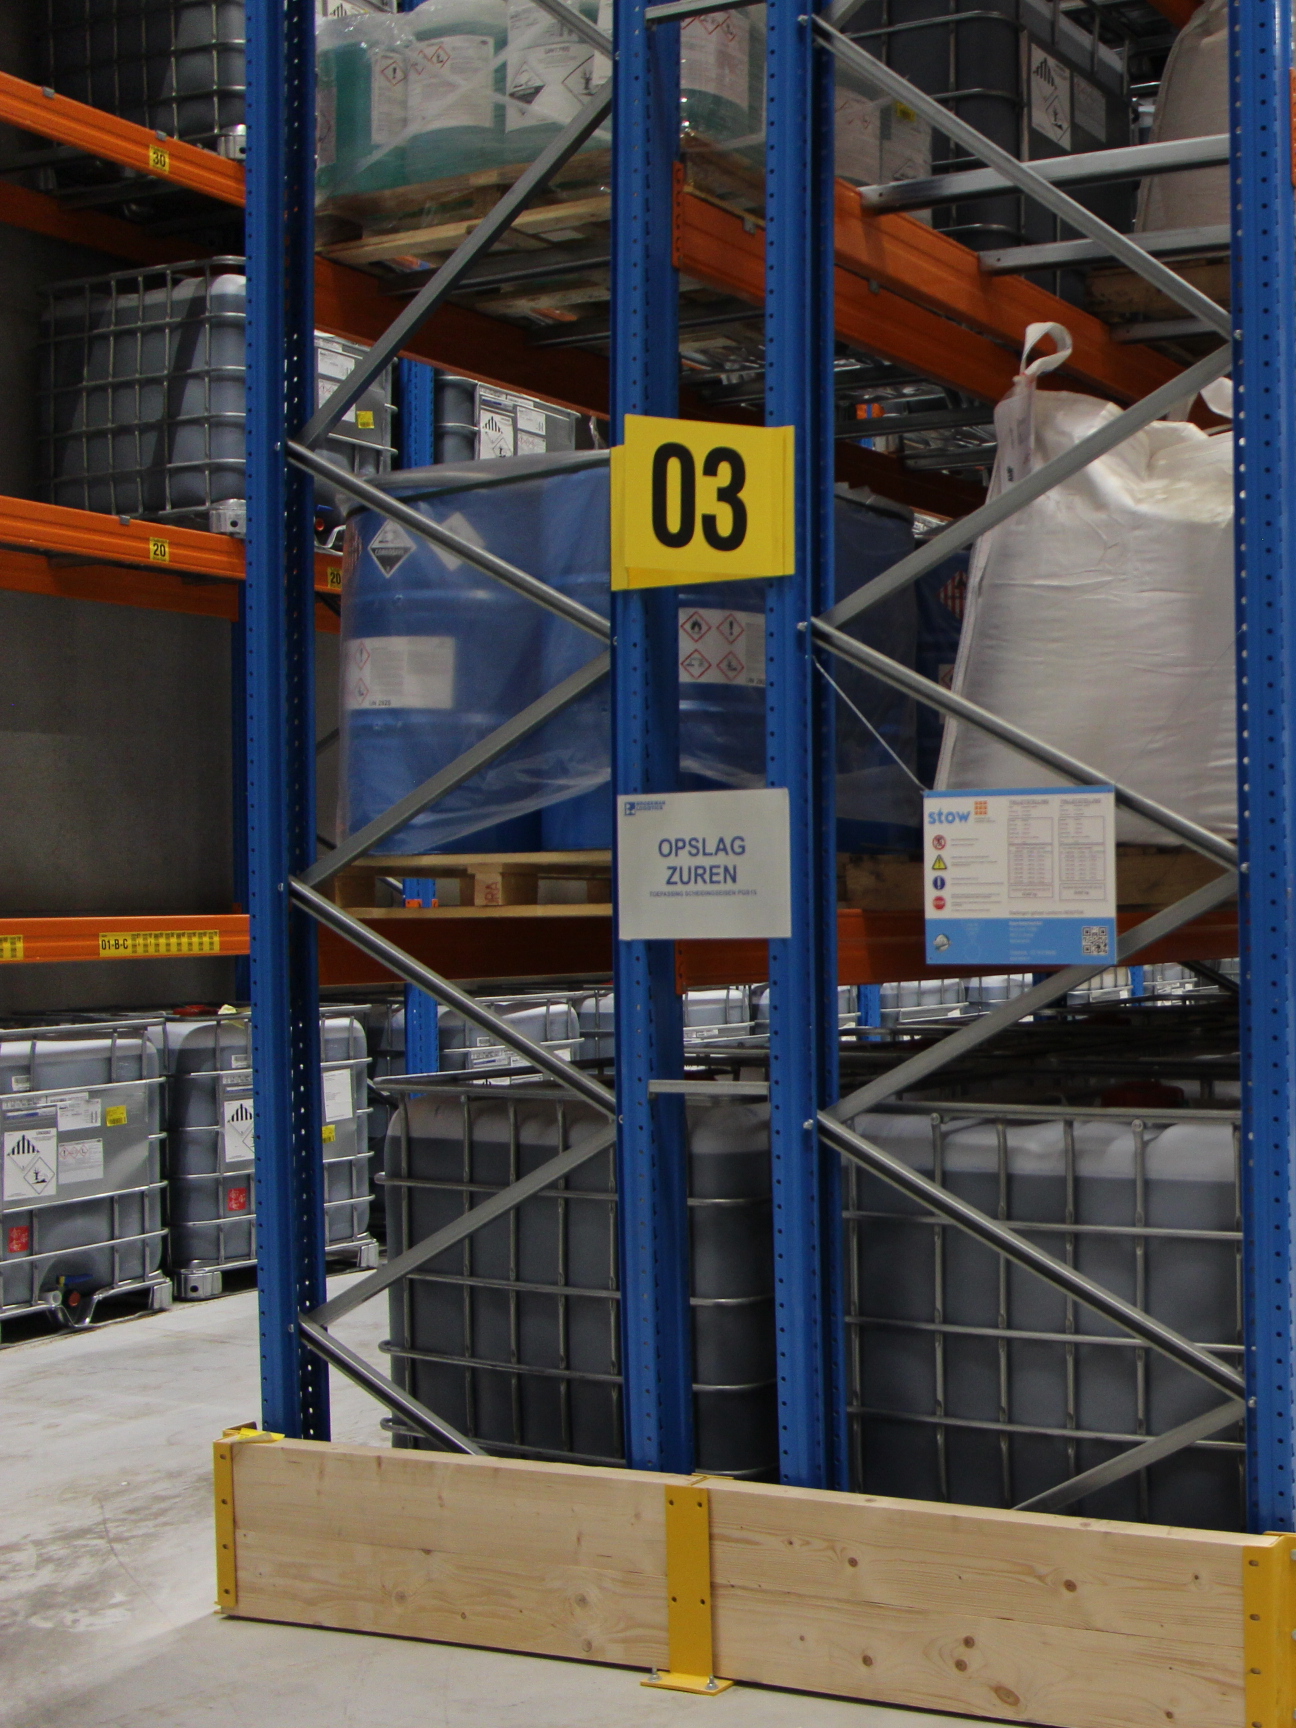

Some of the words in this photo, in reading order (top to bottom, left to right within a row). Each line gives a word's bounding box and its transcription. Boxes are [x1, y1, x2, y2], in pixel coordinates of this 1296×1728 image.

[153, 150, 166, 168] 30
[652, 442, 748, 552] 03
[153, 542, 166, 557] 20
[330, 571, 342, 585] 20
[928, 807, 971, 825] stow
[658, 836, 746, 858] OPSLAG
[665, 864, 737, 885] ZUREN
[101, 938, 128, 950] 01-B-C
